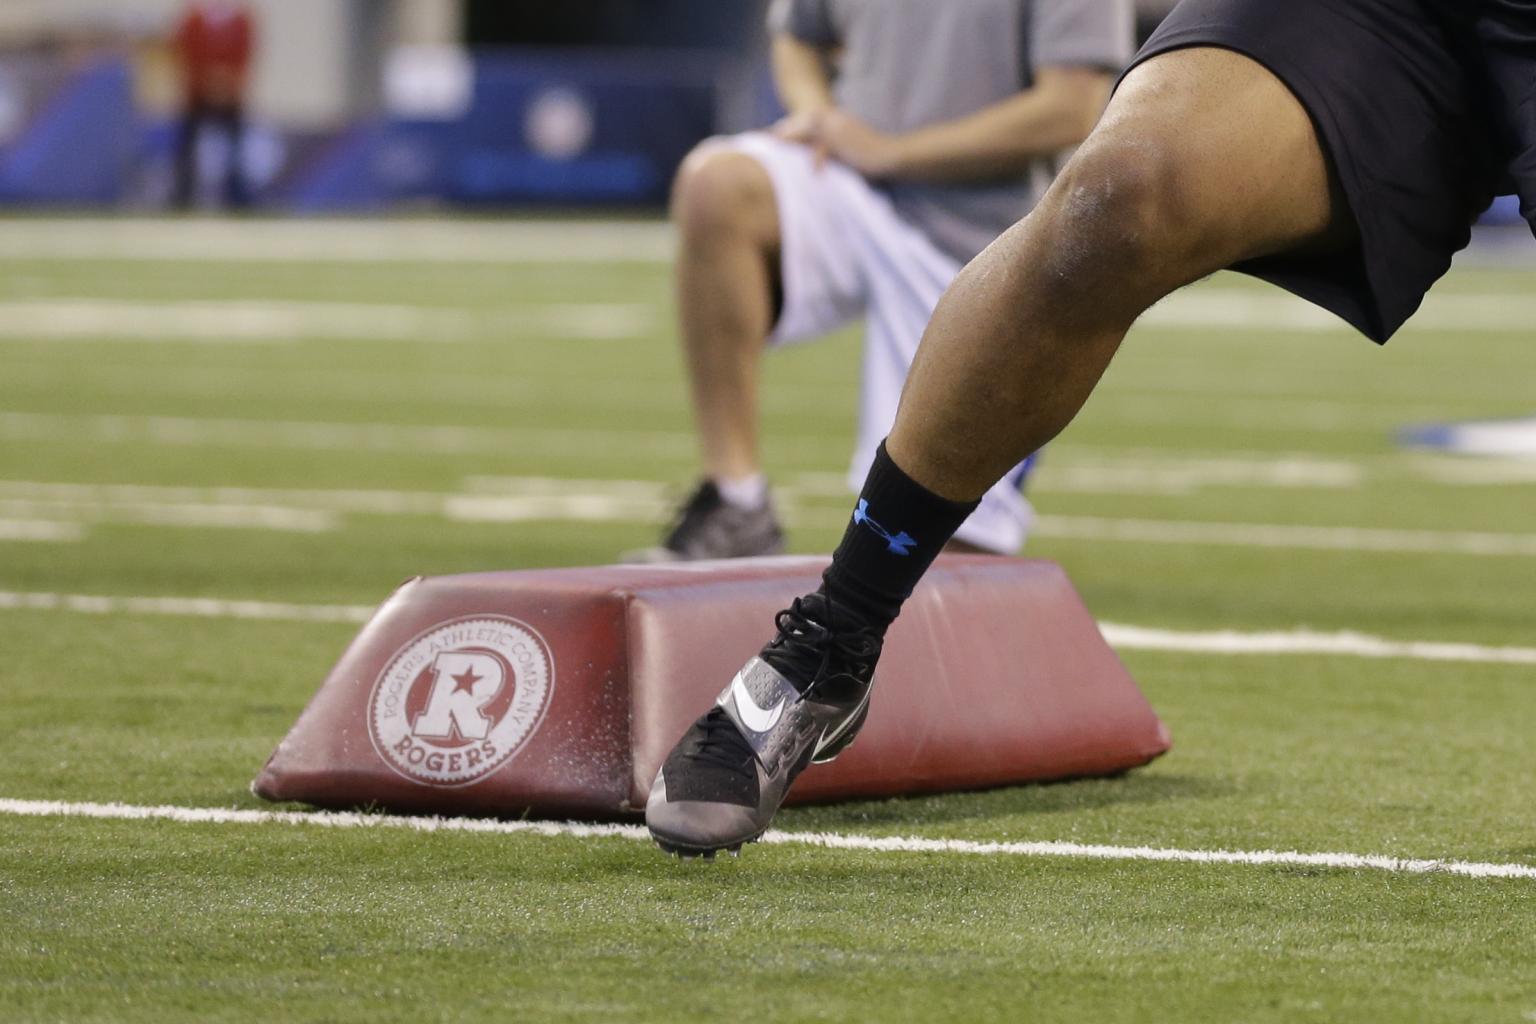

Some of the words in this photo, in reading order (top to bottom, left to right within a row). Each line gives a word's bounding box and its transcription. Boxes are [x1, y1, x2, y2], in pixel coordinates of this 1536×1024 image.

[412, 650, 505, 740] R
[430, 628, 512, 653] ATHLETIC
[511, 642, 537, 725] COMPANY
[393, 735, 497, 772] ROGERS
